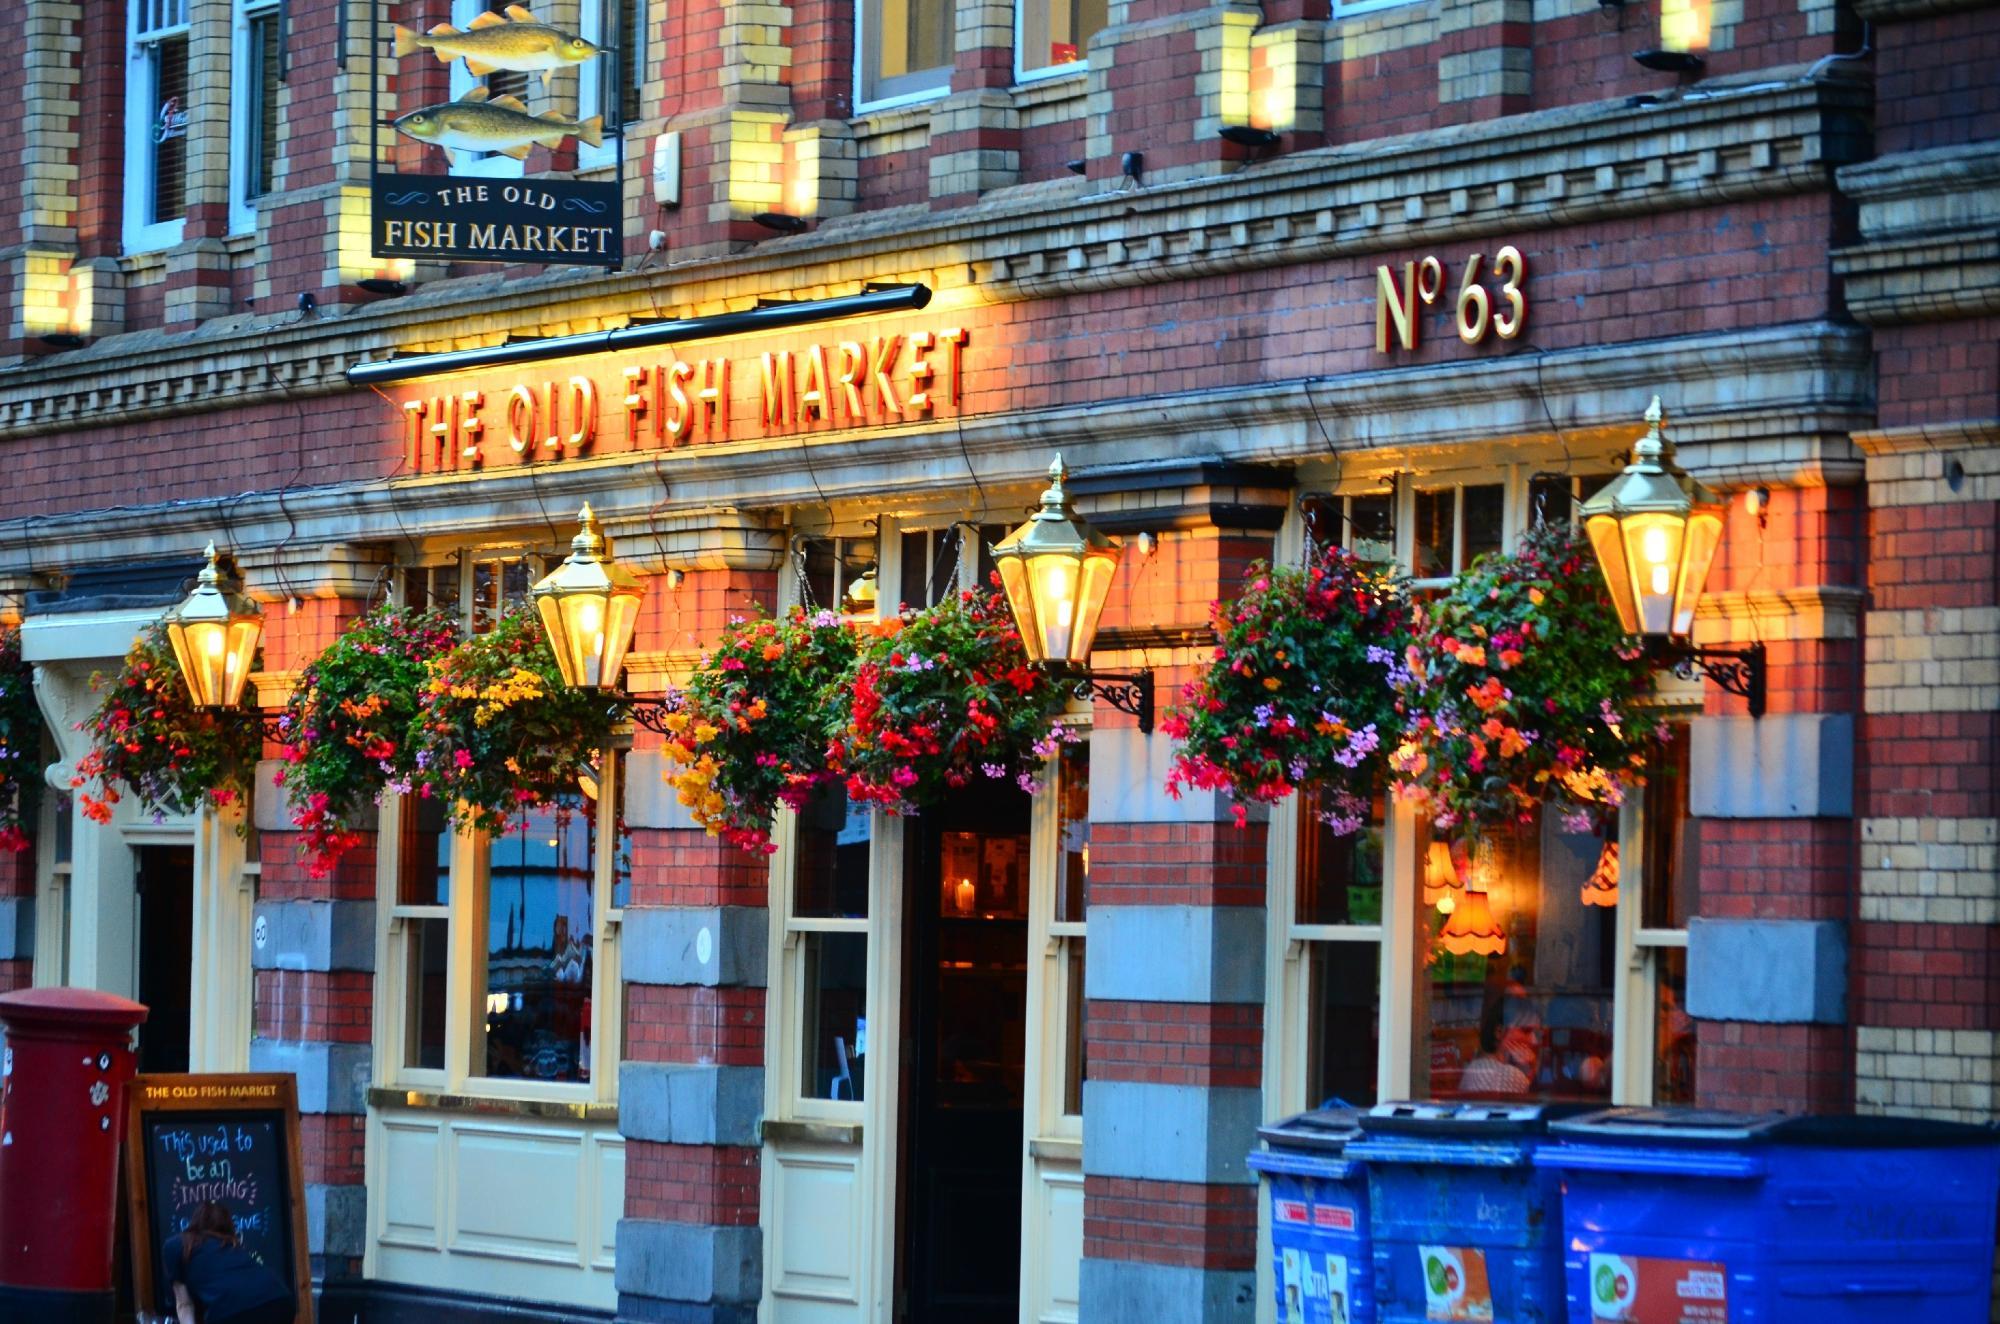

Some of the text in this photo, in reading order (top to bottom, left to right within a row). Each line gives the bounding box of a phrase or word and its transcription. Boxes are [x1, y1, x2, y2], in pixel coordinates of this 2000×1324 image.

[437, 185, 556, 210] THE OLD
[384, 220, 613, 253] FISH MARKET
[1456, 245, 1529, 345] 63
[403, 327, 969, 468] THE OLD FISH MARKET
[146, 1085, 276, 1098] THE OLD FISH MARKET
[160, 1125, 253, 1162] This used to
[187, 1158, 234, 1184] be an
